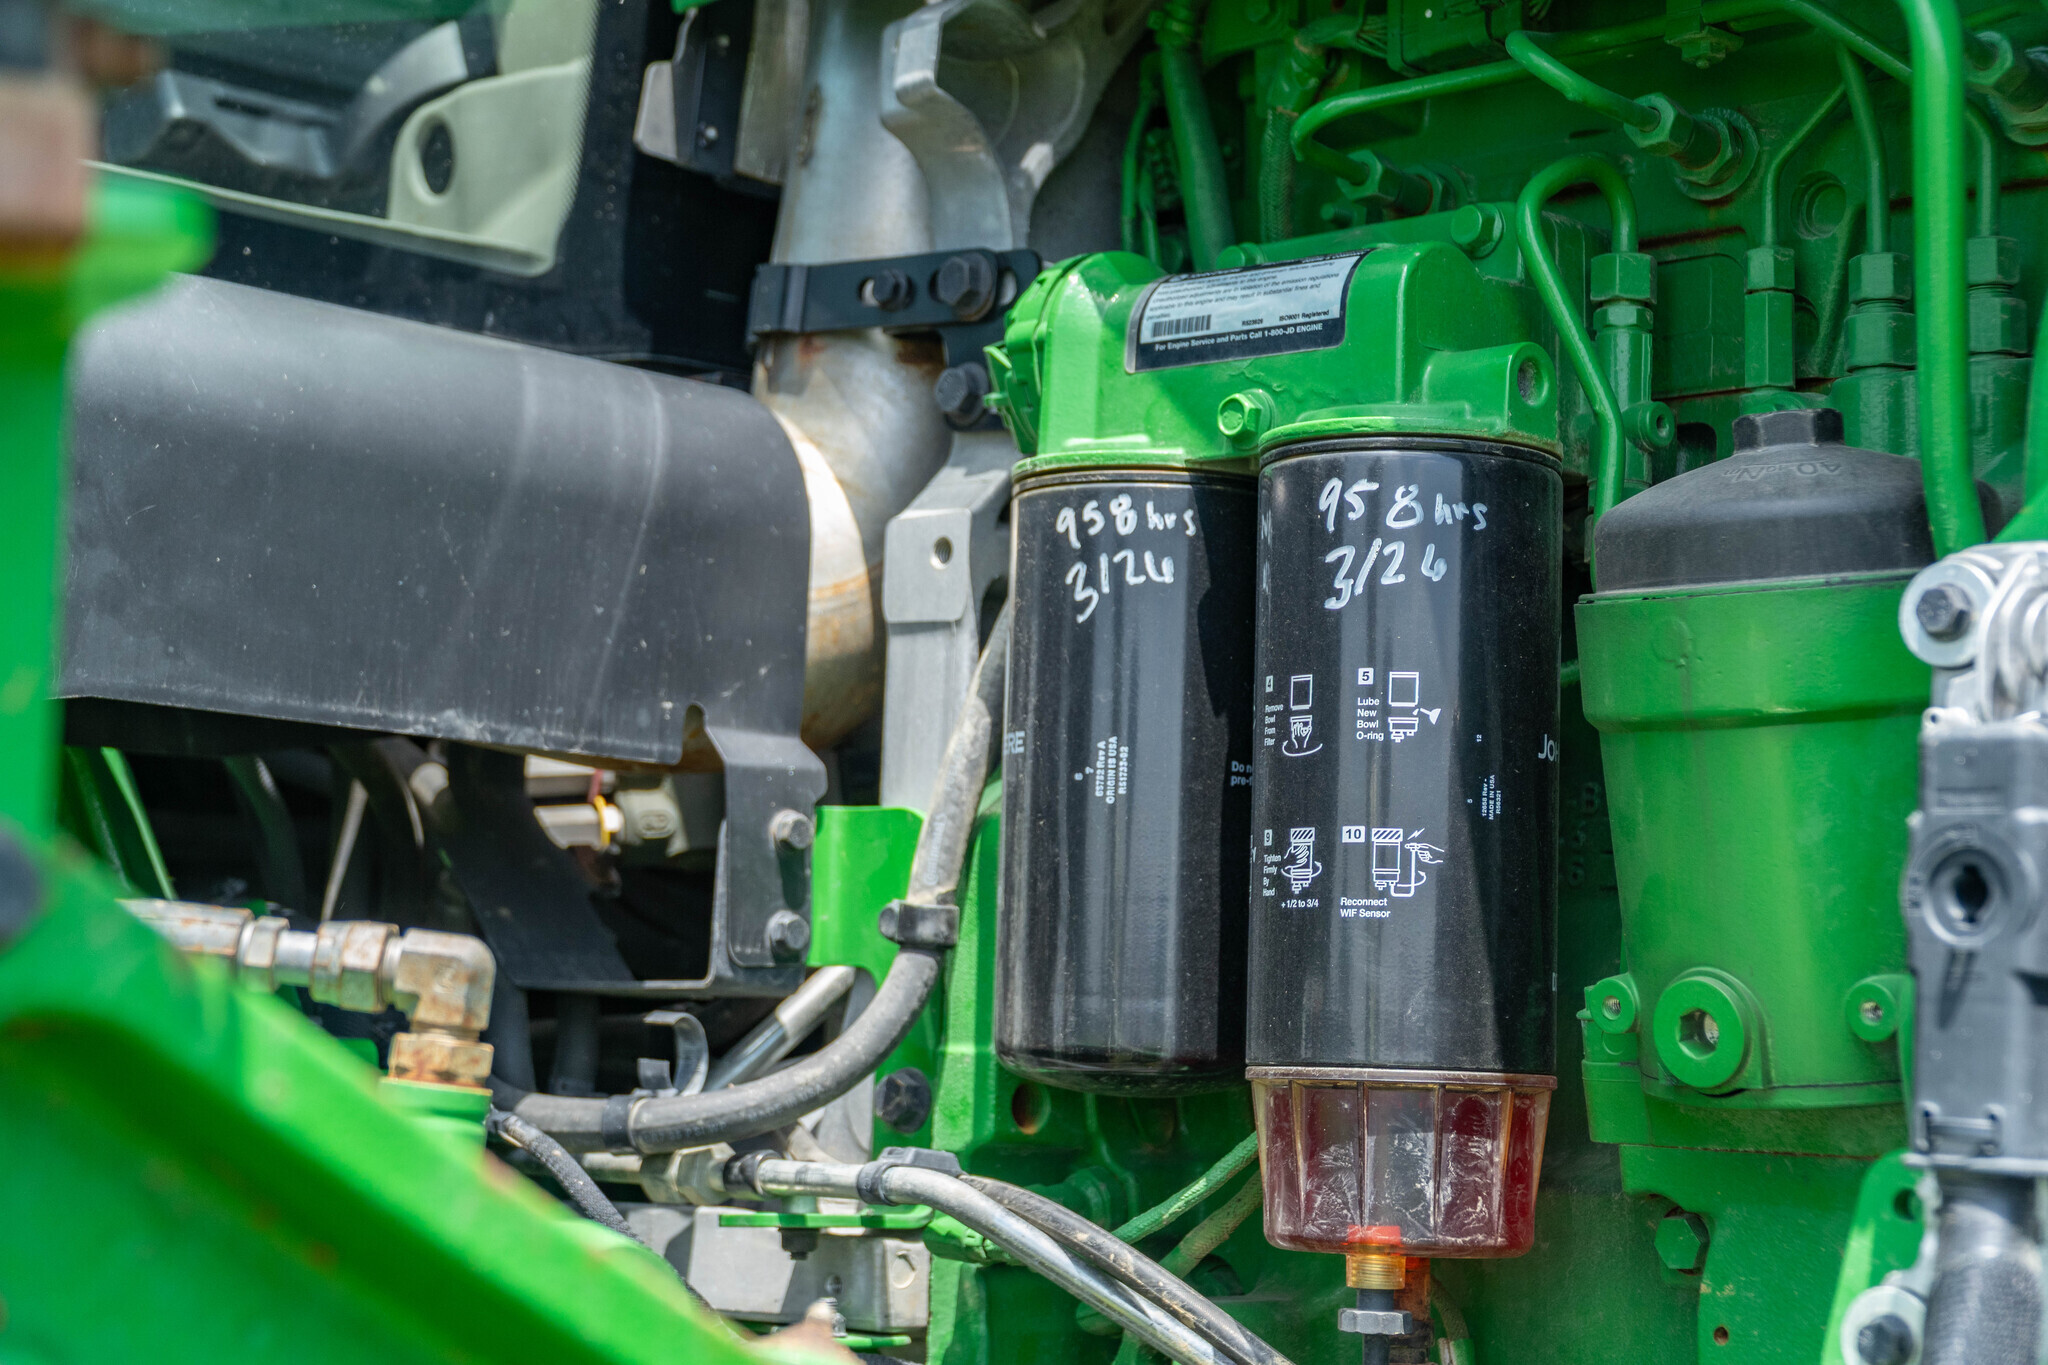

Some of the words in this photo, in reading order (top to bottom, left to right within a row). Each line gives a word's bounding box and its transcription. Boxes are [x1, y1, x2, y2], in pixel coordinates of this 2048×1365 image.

[1301, 309, 1330, 320] Registered
[1155, 343, 1167, 352] For
[1167, 341, 1190, 351] Engine
[1191, 337, 1216, 347] Service
[1216, 335, 1229, 344] and
[1230, 332, 1248, 342] Parts
[1249, 330, 1263, 340] Call
[1296, 323, 1323, 334] ENGINE
[1434, 493, 1488, 530] hrs
[1056, 493, 1138, 550] 958
[1146, 500, 1197, 536] hrs
[1357, 697, 1380, 706] Lube
[1264, 704, 1284, 713] Remove
[1357, 708, 1378, 717] New
[1264, 715, 1276, 724] Bowl
[1356, 719, 1379, 729] Bowl
[1264, 727, 1276, 736] From
[1356, 730, 1385, 742] O-ring
[1097, 740, 1106, 749] A
[1108, 735, 1118, 757] USA
[1263, 737, 1276, 746] Filter
[1231, 760, 1245, 773] Do
[1106, 769, 1116, 804] ORIGIN
[1489, 790, 1495, 798] IN
[1263, 854, 1282, 864] Tighten
[1263, 865, 1278, 875] Firmly
[1262, 876, 1270, 887] By
[1262, 887, 1276, 897] Hand
[1298, 899, 1306, 908] to
[1306, 898, 1319, 908] 3/4
[1340, 897, 1388, 906] Reconnect
[1340, 908, 1357, 918] WIF
[1358, 908, 1391, 918] Sensor
